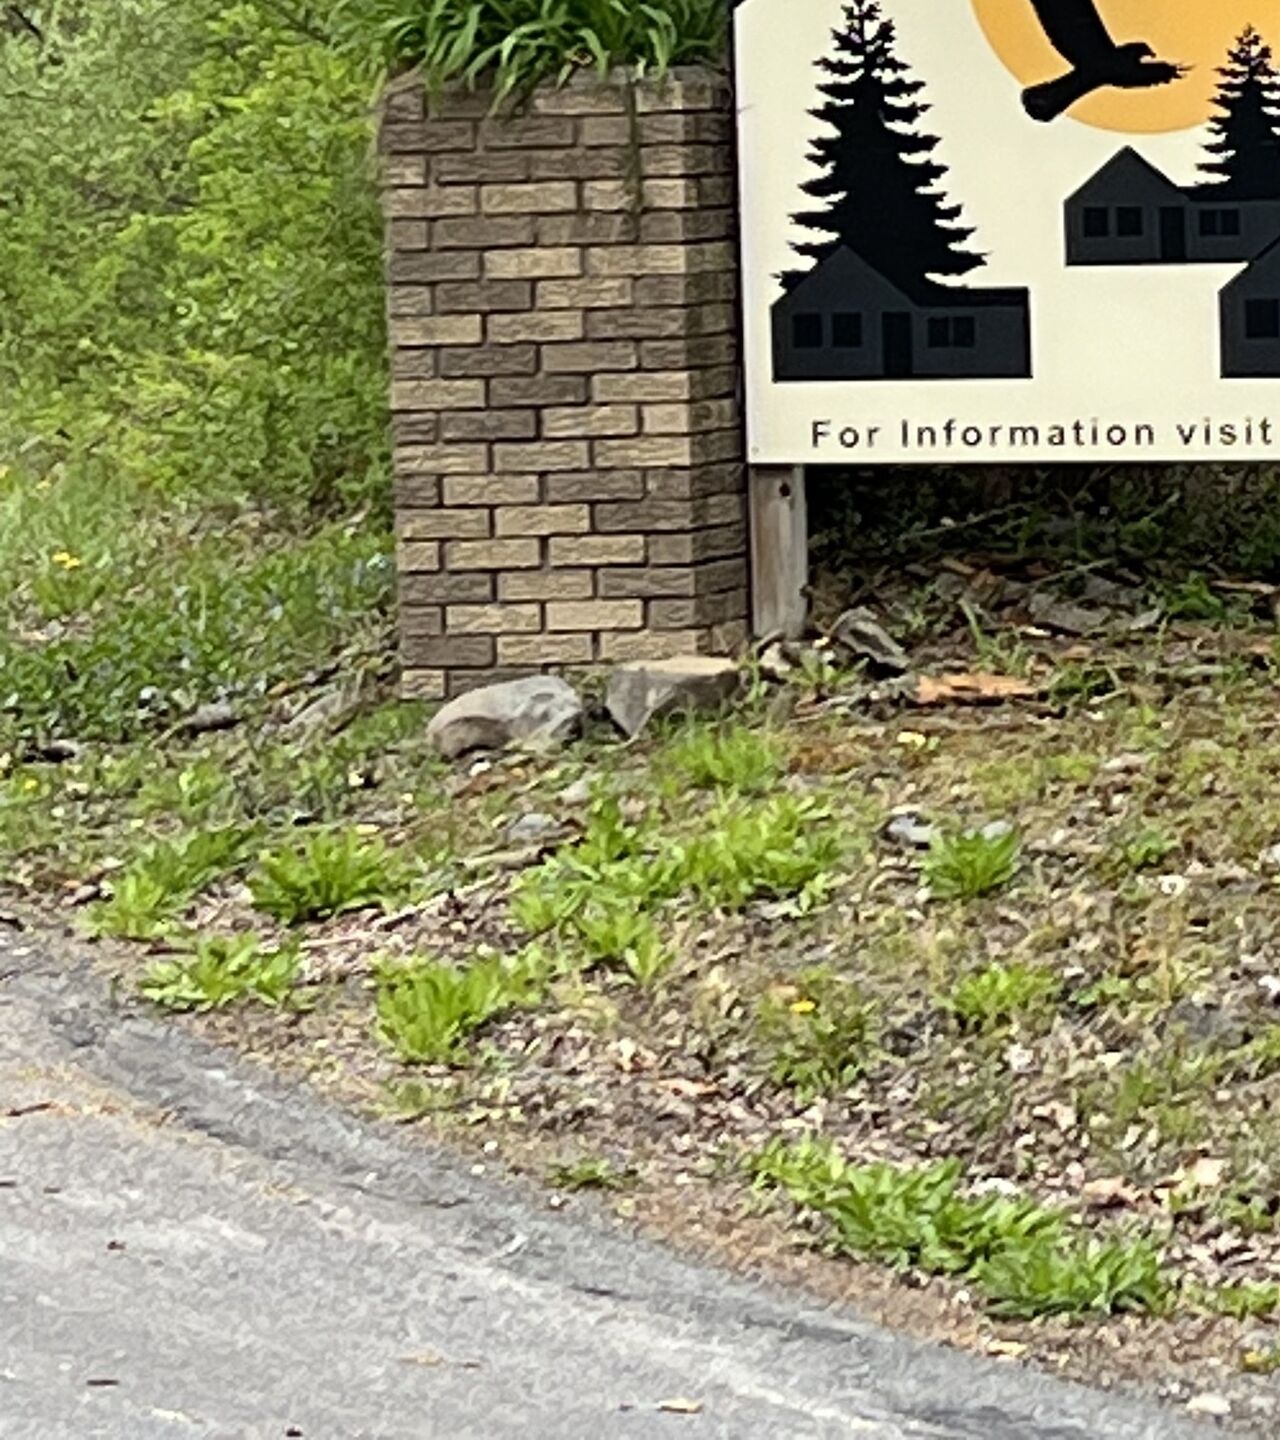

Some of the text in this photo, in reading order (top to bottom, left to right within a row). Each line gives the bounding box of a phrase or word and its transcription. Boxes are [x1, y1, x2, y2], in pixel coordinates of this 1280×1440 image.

[811, 419, 880, 449] For
[901, 417, 1155, 448] Information
[1176, 417, 1273, 446] visit
